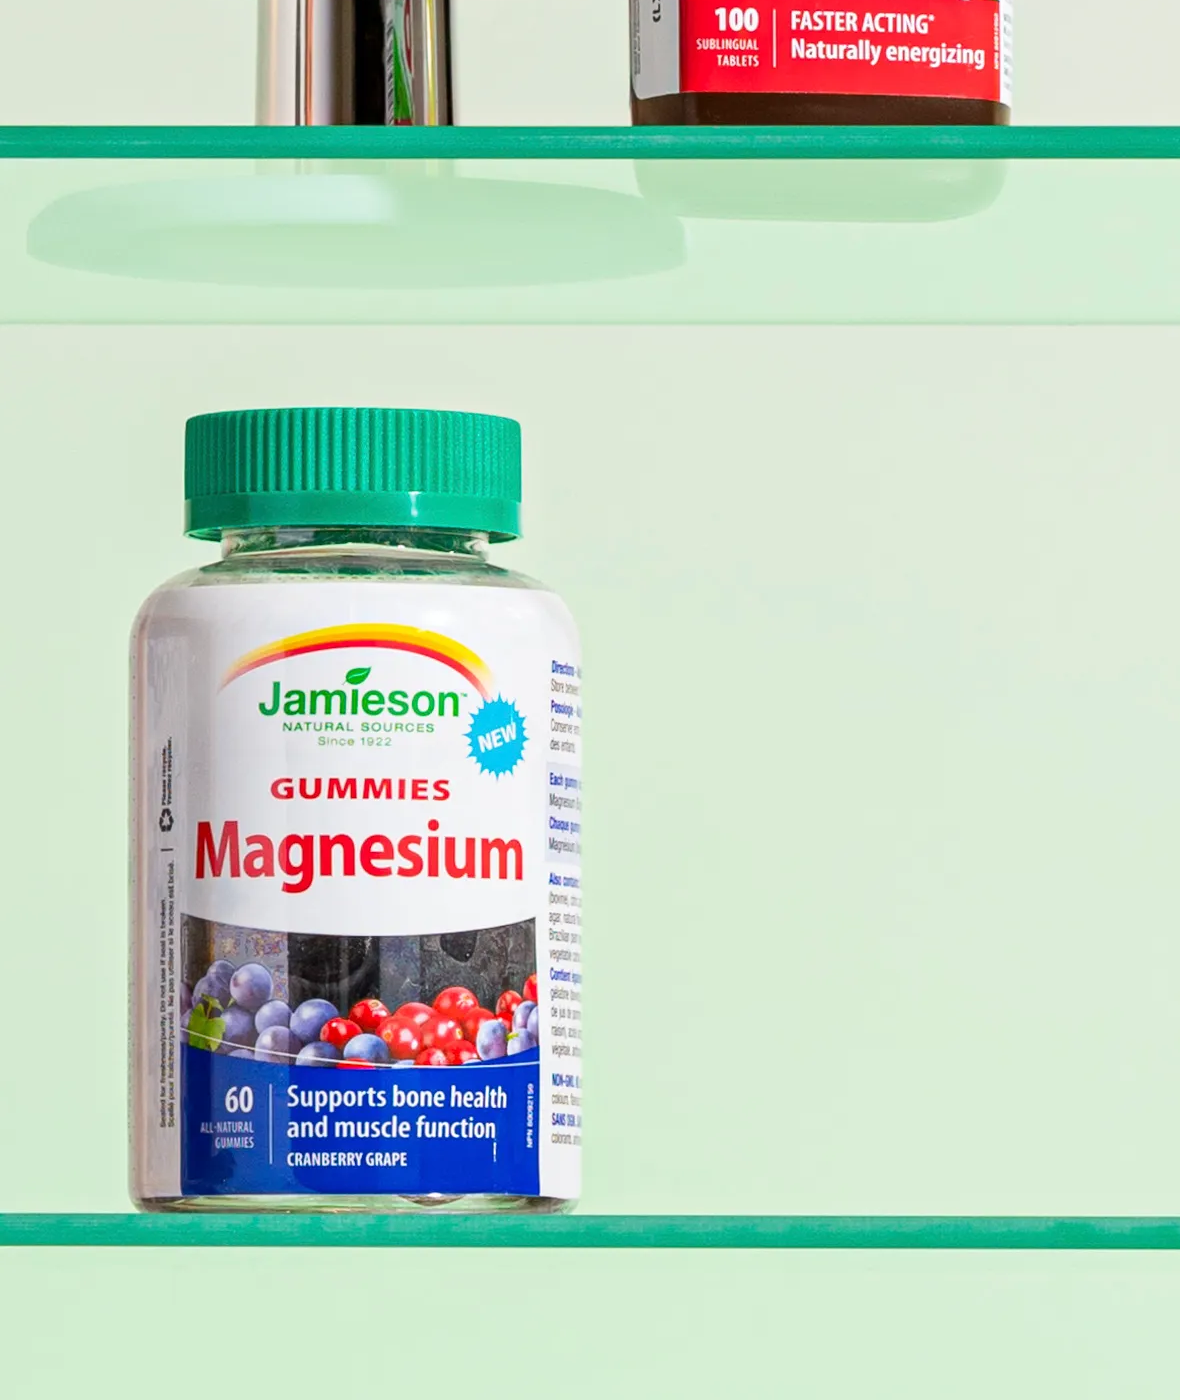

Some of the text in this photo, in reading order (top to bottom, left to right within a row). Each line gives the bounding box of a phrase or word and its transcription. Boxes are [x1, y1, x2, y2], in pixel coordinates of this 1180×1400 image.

[715, 7, 760, 32] 100
[791, 10, 858, 32] FASTER
[696, 37, 759, 52] SUBLINGUAL
[791, 38, 986, 70] Naturally energizing
[717, 54, 760, 68] TABLETS
[258, 681, 459, 718] Jamieson
[282, 721, 434, 733] NATURAL SOURCES
[477, 721, 517, 754] NEW
[318, 736, 392, 747] Since 1922
[270, 777, 451, 801] GUMMIES
[195, 818, 524, 893] Magnesium
[224, 1085, 254, 1114] 60
[286, 1084, 507, 1114] Supports bone health
[200, 1121, 255, 1134] ALL-NATURAL
[286, 1115, 496, 1139] and muscle function
[215, 1136, 255, 1149] GUMMIES
[286, 1151, 408, 1167] CRANBERRY GRAPE
